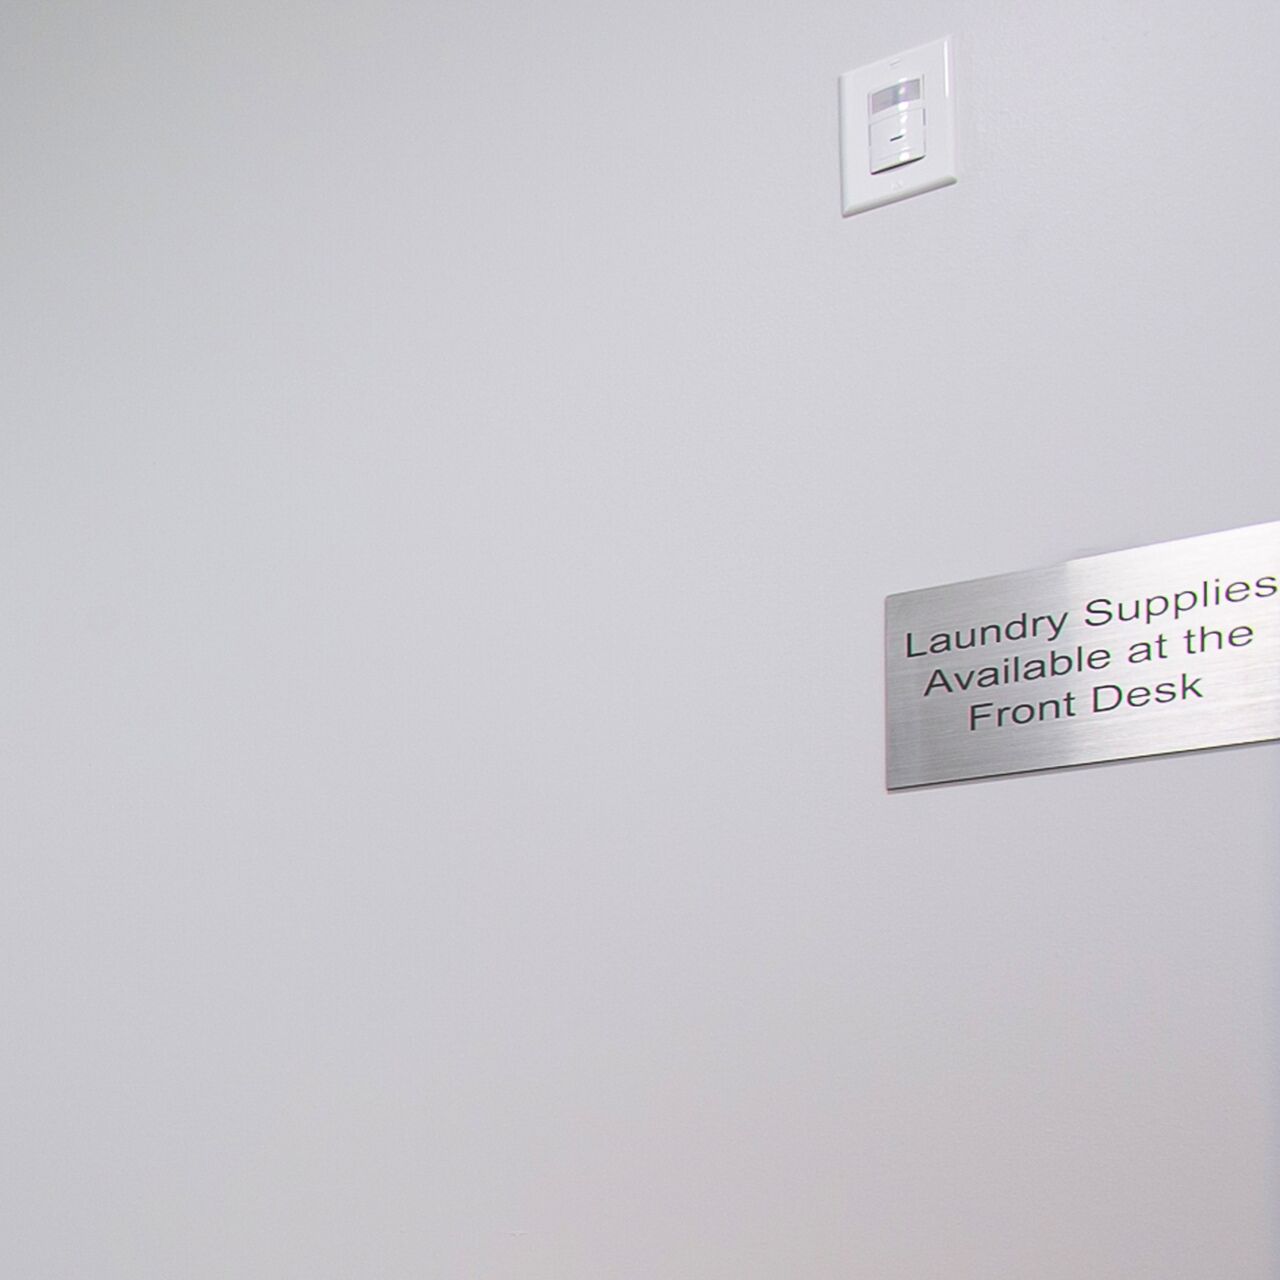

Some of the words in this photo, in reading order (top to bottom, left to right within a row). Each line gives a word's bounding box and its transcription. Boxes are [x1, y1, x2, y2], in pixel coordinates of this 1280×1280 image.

[905, 611, 1069, 659] Laundry
[1084, 575, 1278, 628] Supplies
[923, 645, 1111, 698] Available
[1127, 633, 1168, 665] at
[1183, 624, 1255, 656] the
[968, 691, 1077, 732] Front
[1092, 672, 1204, 714] Desk
